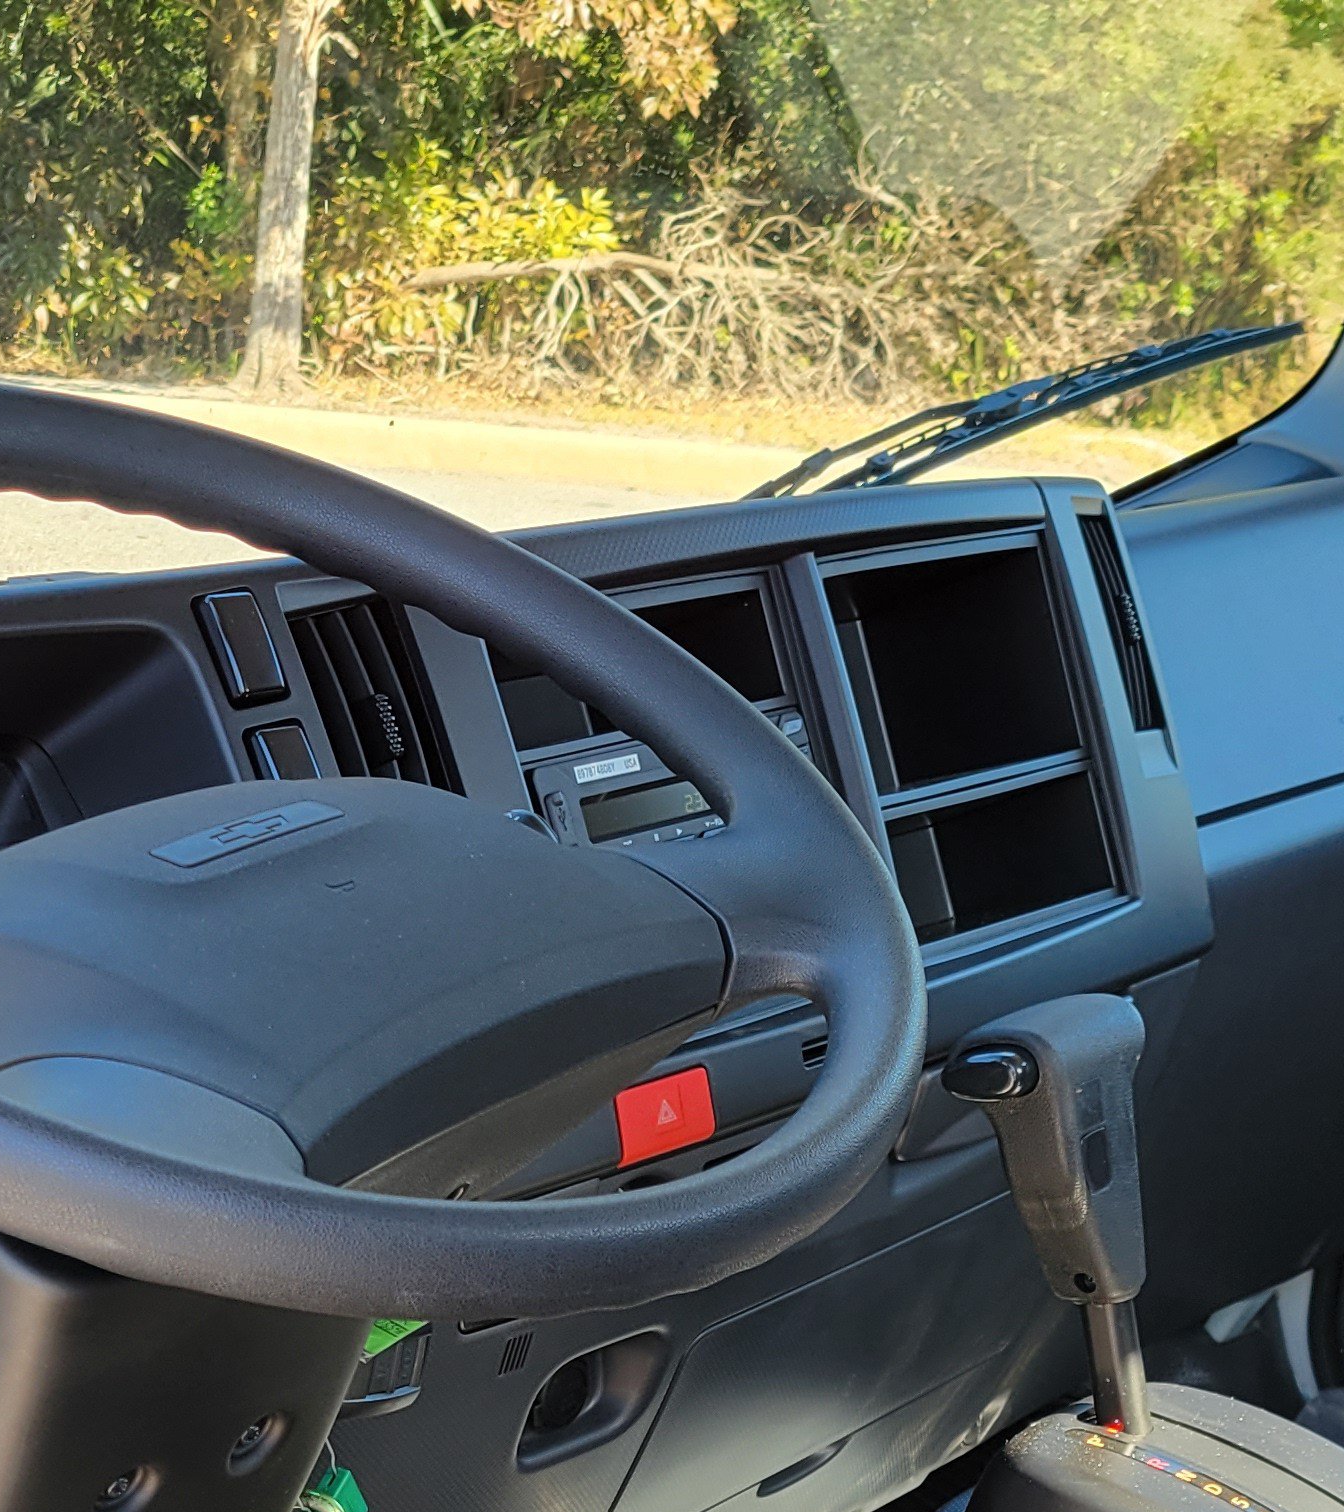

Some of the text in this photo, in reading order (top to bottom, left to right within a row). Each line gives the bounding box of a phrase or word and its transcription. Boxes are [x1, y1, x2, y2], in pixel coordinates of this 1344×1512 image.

[623, 758, 638, 770] USA
[1086, 1434, 1105, 1448] P
[1147, 1457, 1170, 1471] R
[1175, 1469, 1198, 1482] N
[1203, 1482, 1223, 1496] D
